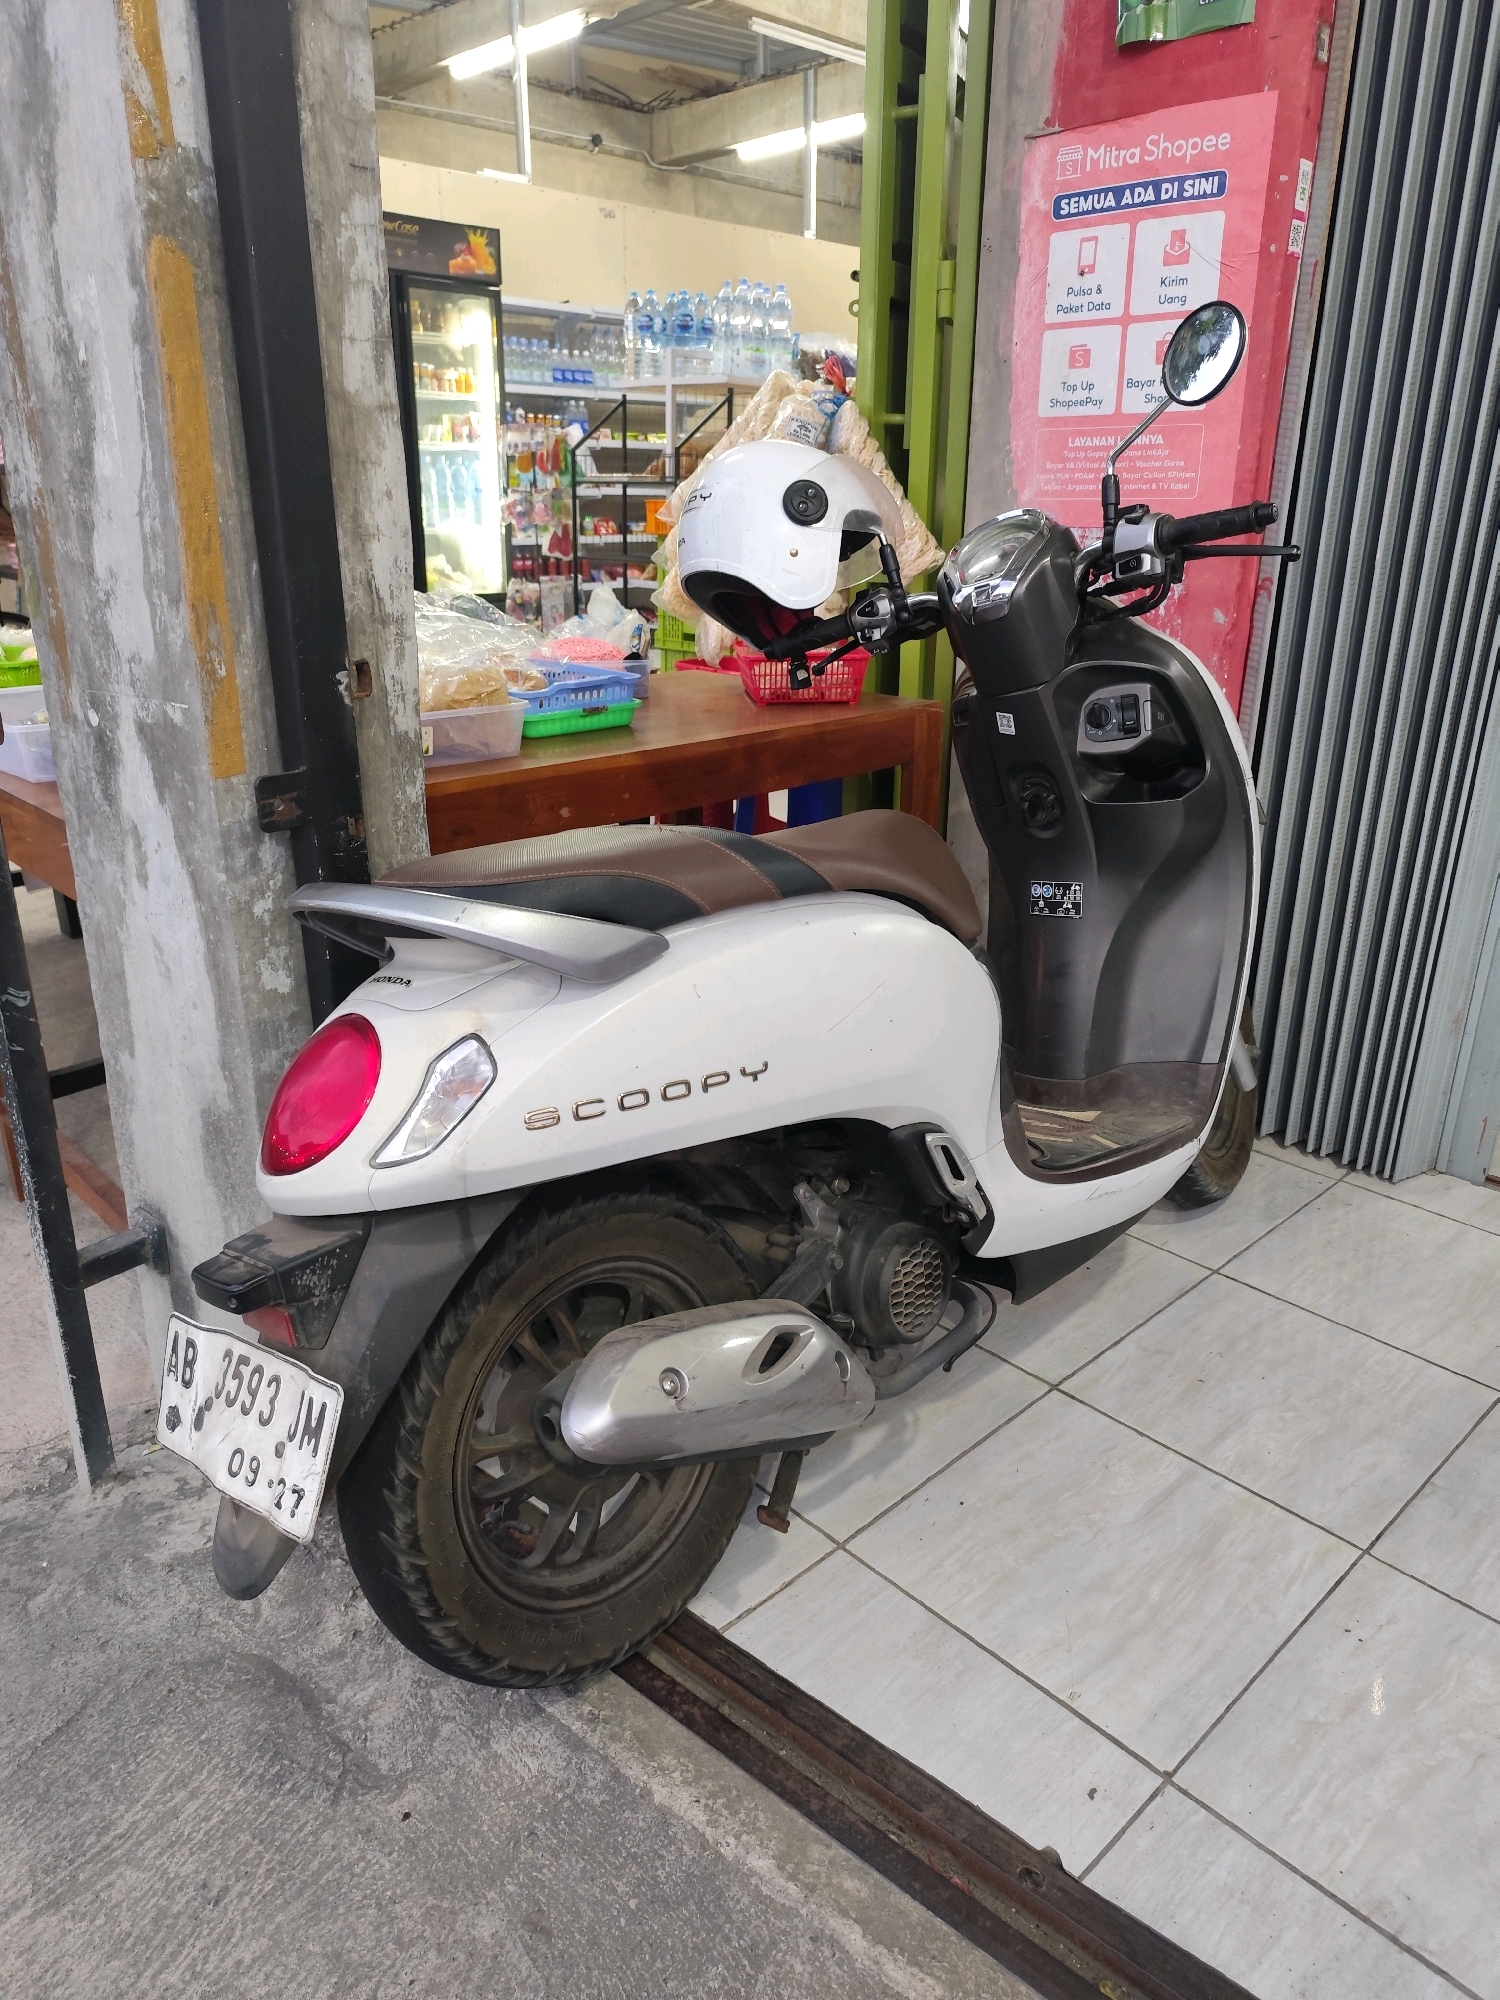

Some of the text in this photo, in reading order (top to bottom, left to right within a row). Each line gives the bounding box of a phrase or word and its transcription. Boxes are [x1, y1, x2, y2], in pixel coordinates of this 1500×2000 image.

[1086, 132, 1231, 172] Mitra Shopee
[1060, 175, 1219, 215] SEMUA ADA DI SINI
[1160, 275, 1189, 288] Kirim
[1066, 283, 1103, 298] Pulsa &
[1158, 293, 1188, 307] Uang
[1056, 301, 1111, 315] Paket Data
[1061, 380, 1095, 395] Top Up
[1126, 377, 1157, 391] Bayar
[1049, 396, 1103, 411] ShopeePay
[1067, 435, 1115, 447] LAYANAN
[1064, 450, 1076, 459] Top
[1076, 450, 1086, 459] Up
[1046, 461, 1064, 471] Bayar
[1065, 461, 1075, 469] VA
[1135, 459, 1163, 468] Voucher
[1164, 459, 1185, 467] Game
[1056, 472, 1070, 480] PLN
[1074, 472, 1095, 480] PDAM
[1122, 472, 1141, 480] Bayar
[1067, 483, 1097, 492] Angsuran
[1158, 482, 1168, 490] TV
[1169, 482, 1190, 490] Kabel
[367, 975, 413, 989] HONDA
[523, 1059, 769, 1131] SCOOPY
[166, 1329, 329, 1459] AB 3593 JM
